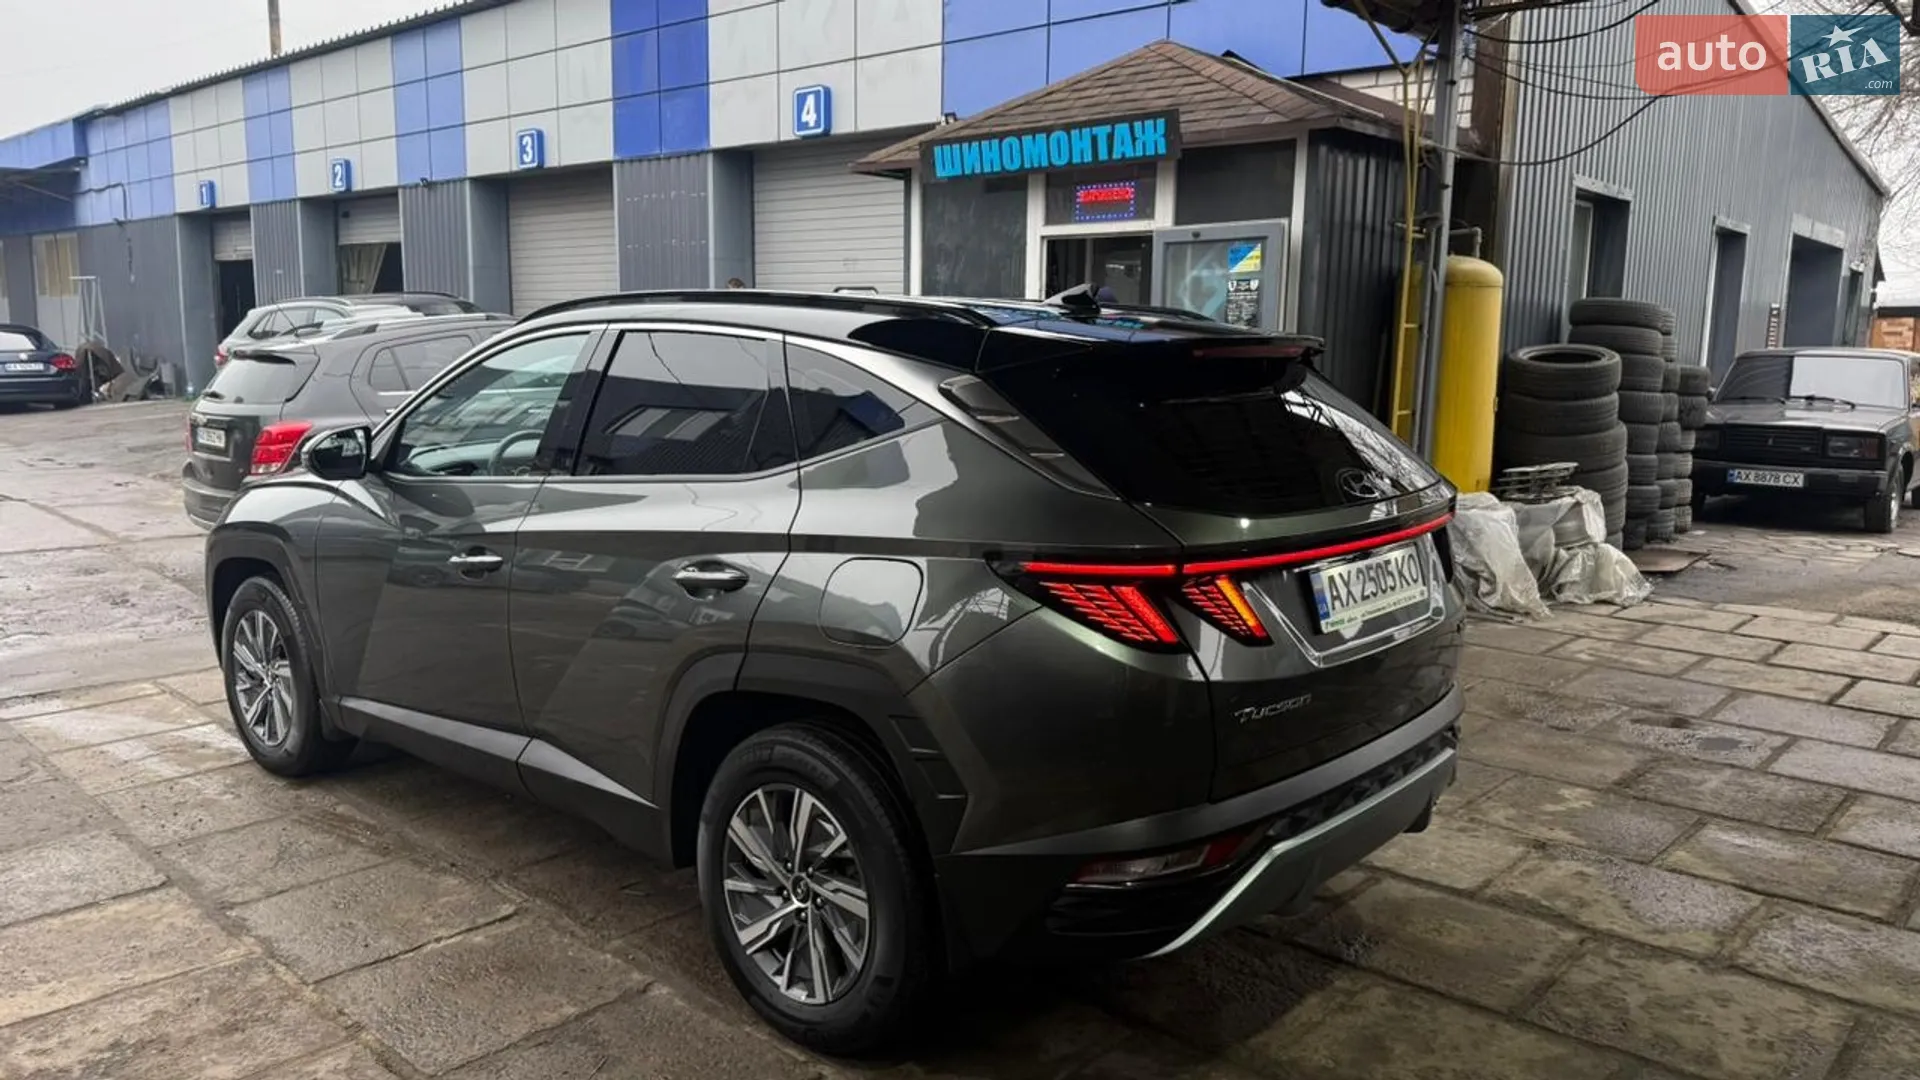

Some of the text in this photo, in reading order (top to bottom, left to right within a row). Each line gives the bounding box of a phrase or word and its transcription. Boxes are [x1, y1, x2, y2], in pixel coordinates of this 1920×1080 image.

[801, 94, 817, 127] 4
[522, 136, 533, 162] 3
[933, 118, 1166, 178] ШИНОМОНТАЖ
[333, 164, 345, 187] 2
[1328, 553, 1419, 610] AX 2505 KO
